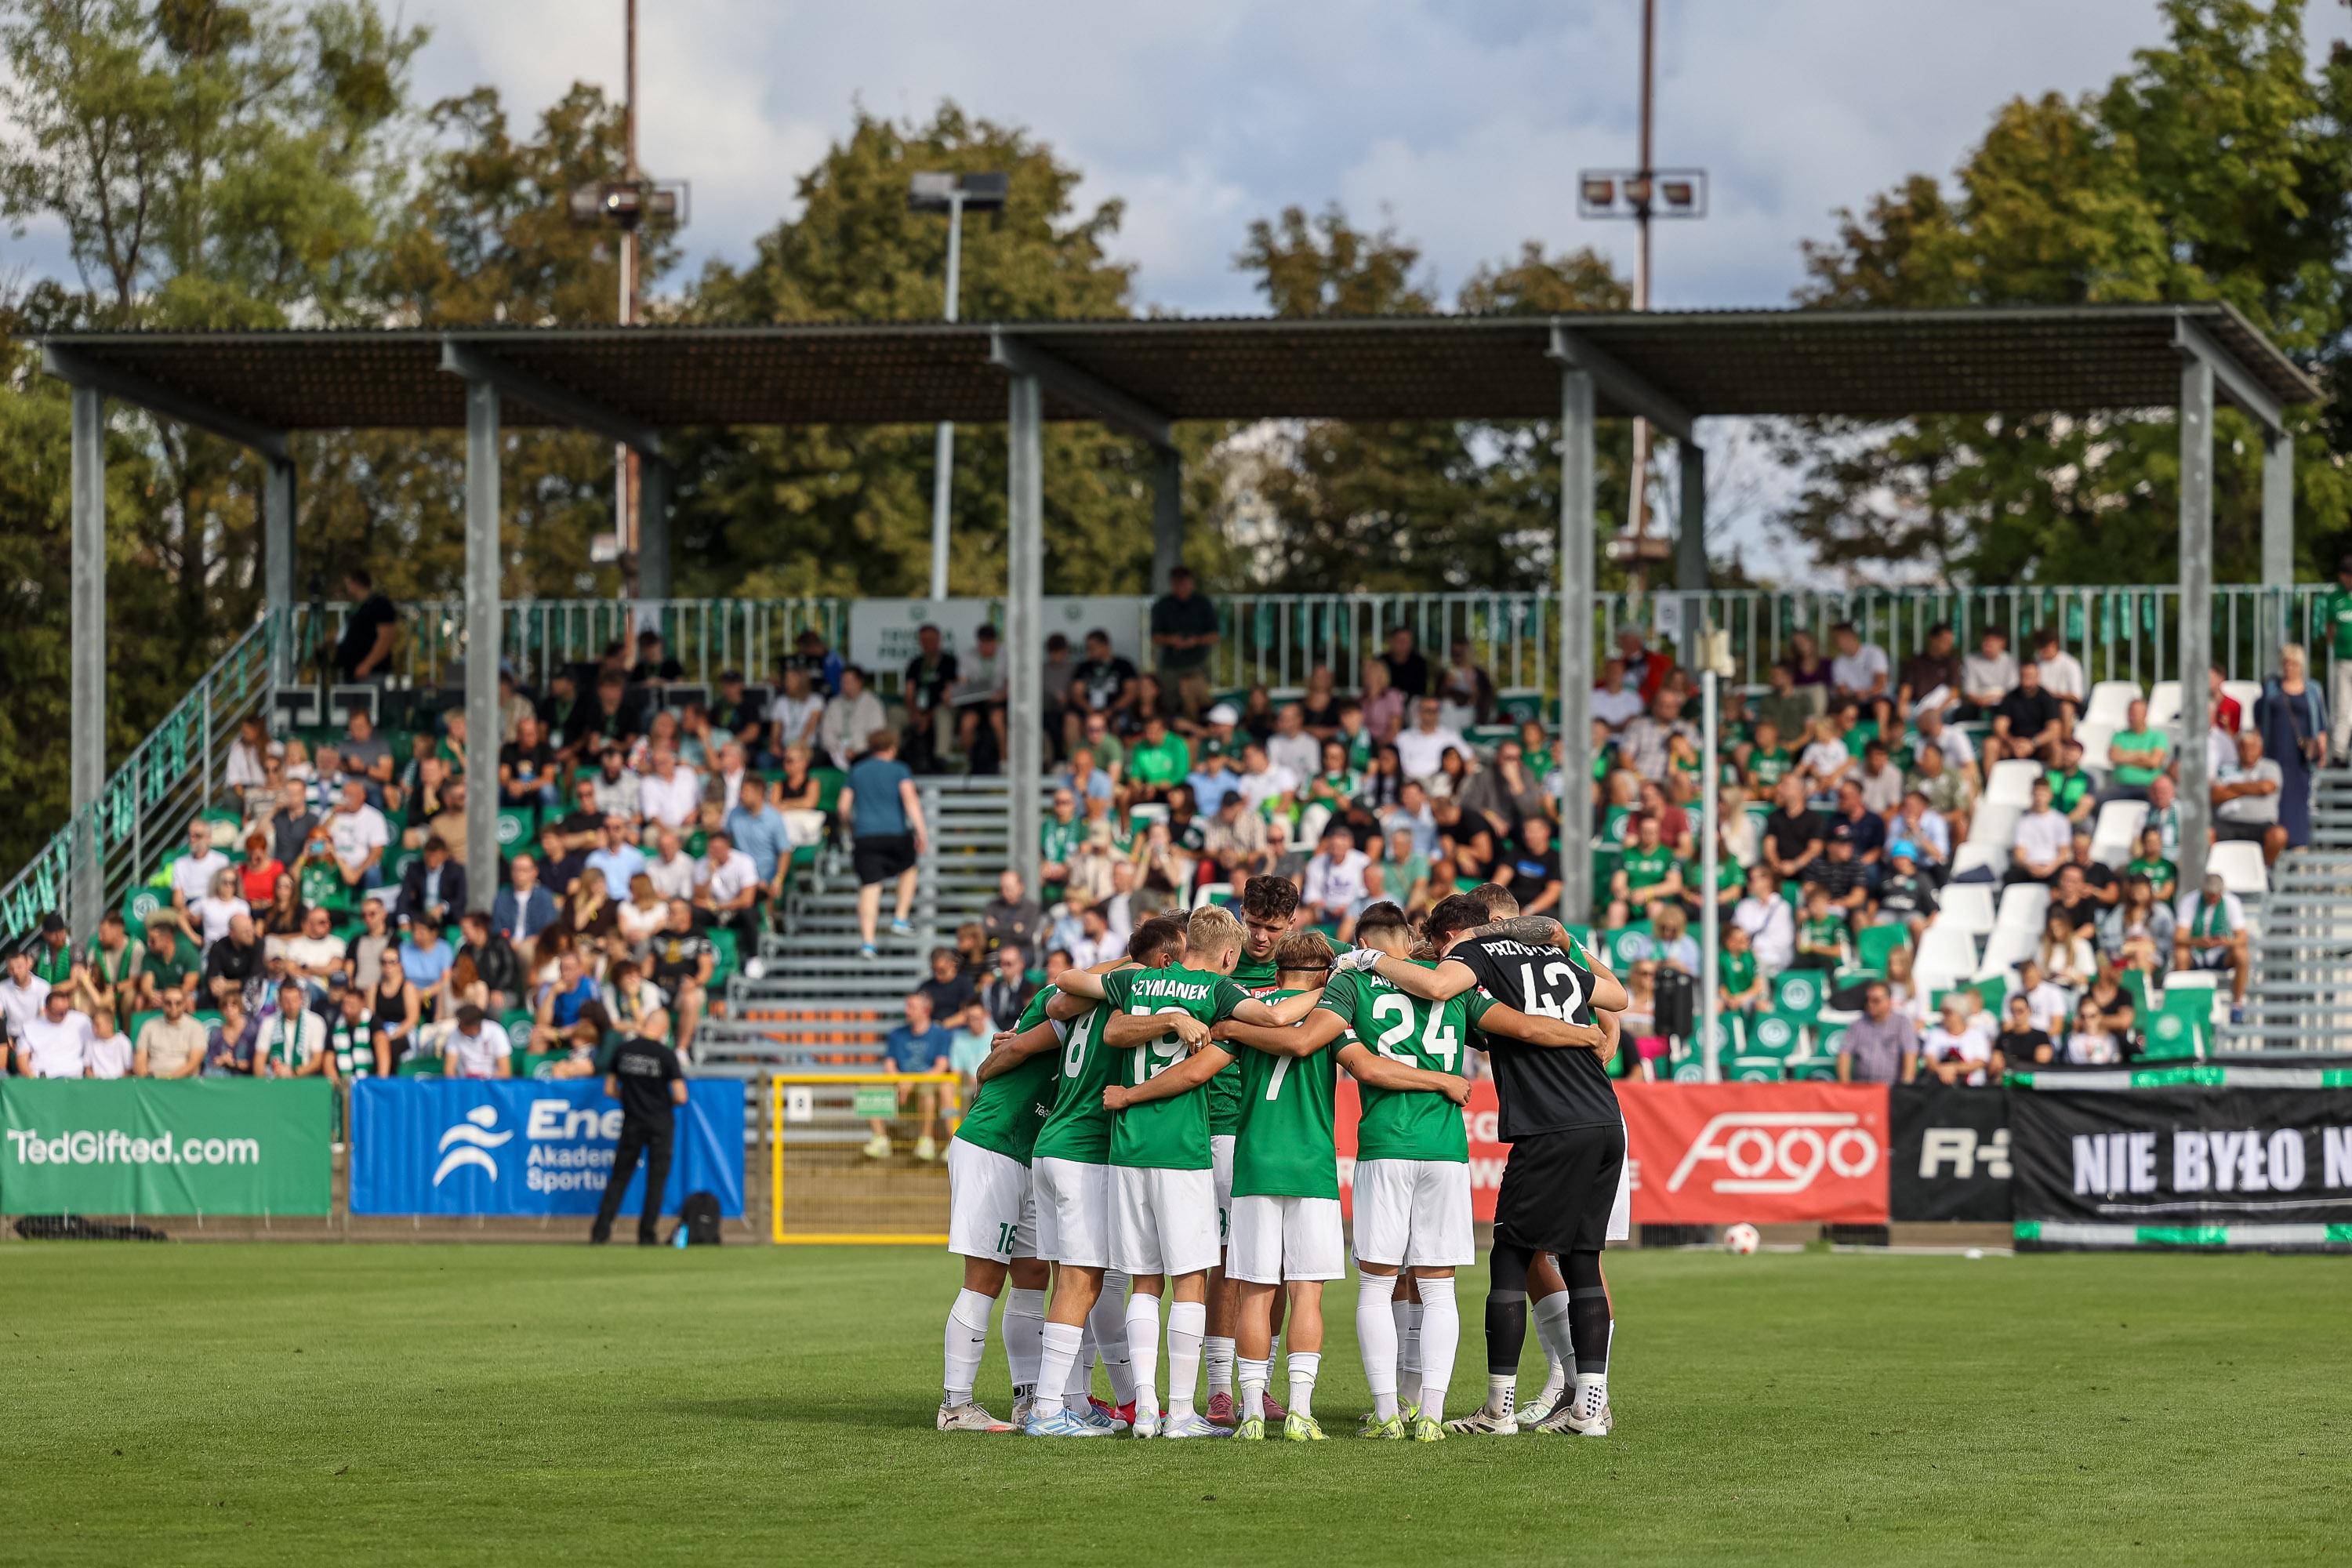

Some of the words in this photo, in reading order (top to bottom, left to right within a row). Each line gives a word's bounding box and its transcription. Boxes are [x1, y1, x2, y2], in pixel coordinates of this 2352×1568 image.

[1520, 961, 1590, 1028] 42
[1065, 1005, 1098, 1078] 8
[1131, 1004, 1191, 1085] 19
[1372, 993, 1458, 1072] 24
[7, 1128, 260, 1165] TedGifted.com
[2071, 1132, 2158, 1195] NIE
[2172, 1127, 2307, 1192] BYŁO
[527, 1166, 608, 1195] Sportu
[996, 1221, 1018, 1255] 16
